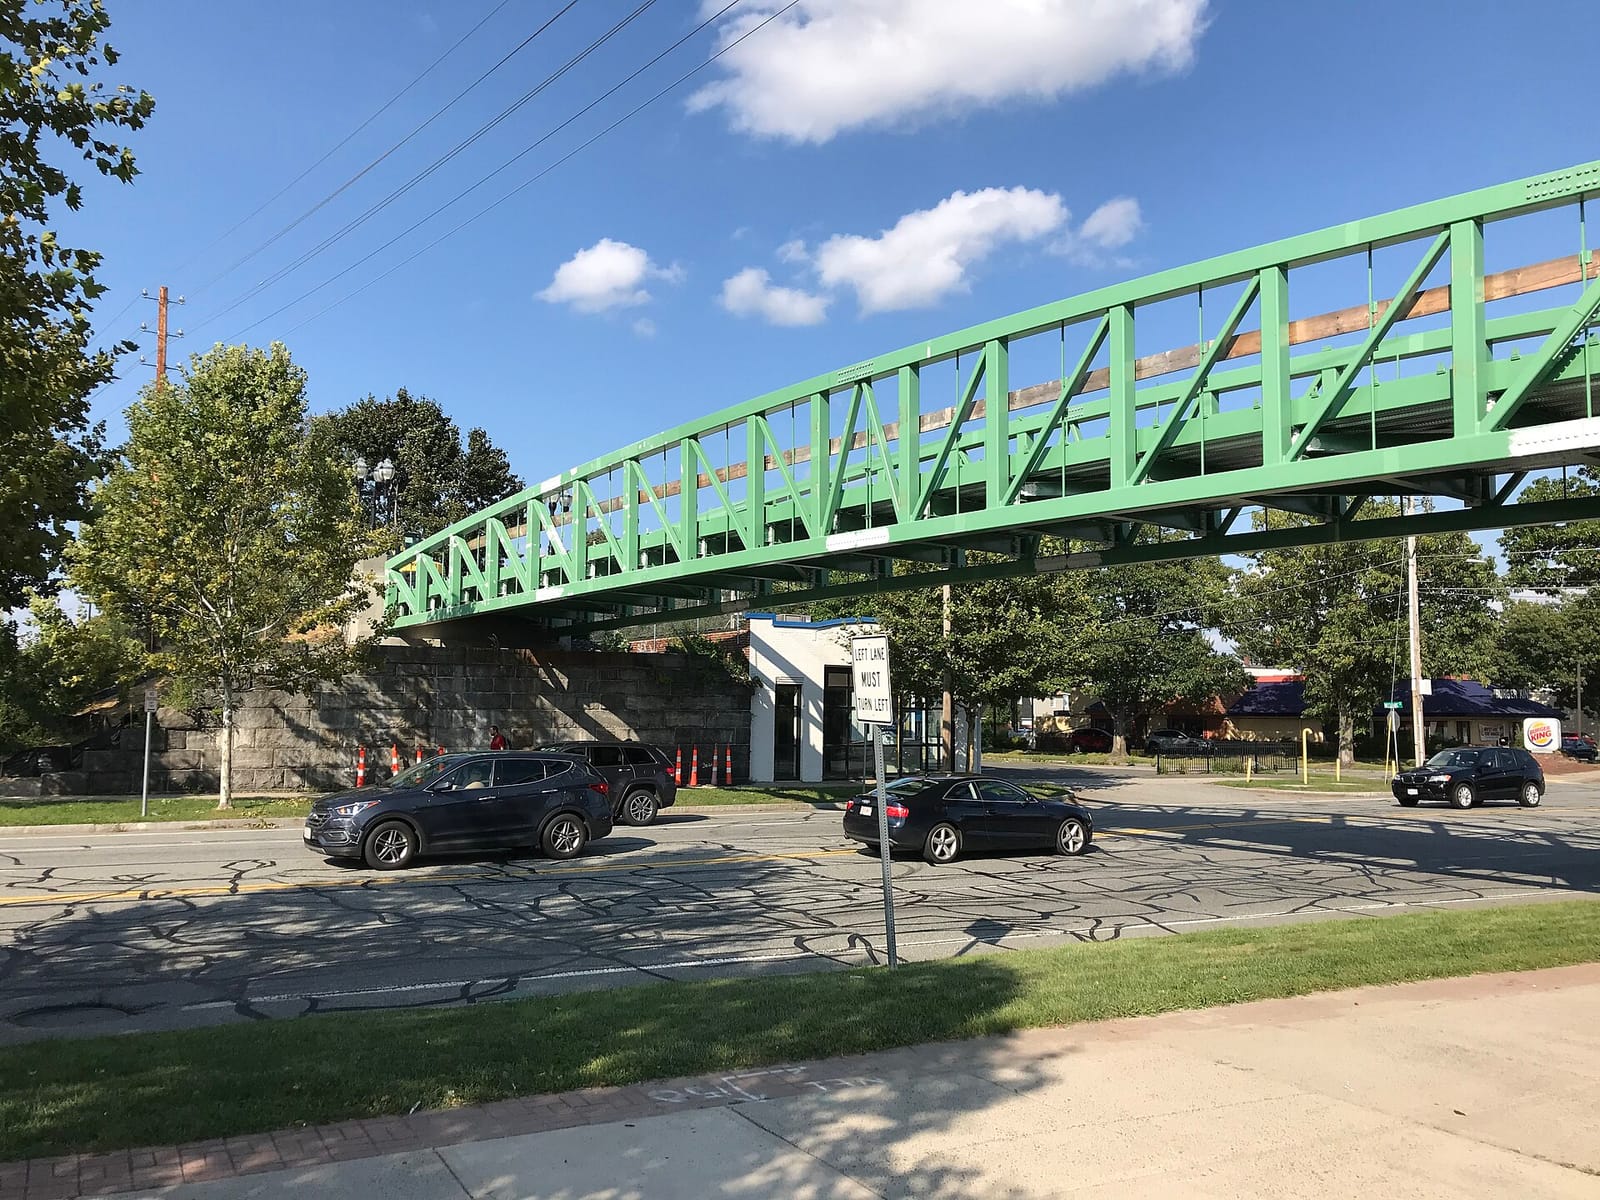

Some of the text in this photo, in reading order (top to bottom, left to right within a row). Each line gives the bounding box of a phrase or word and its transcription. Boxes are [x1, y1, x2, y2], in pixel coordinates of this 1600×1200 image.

[855, 647, 885, 660] LEFT LANE
[861, 671, 880, 687] MUST
[858, 698, 888, 711] TURN LEFT
[1530, 729, 1551, 741] KING
